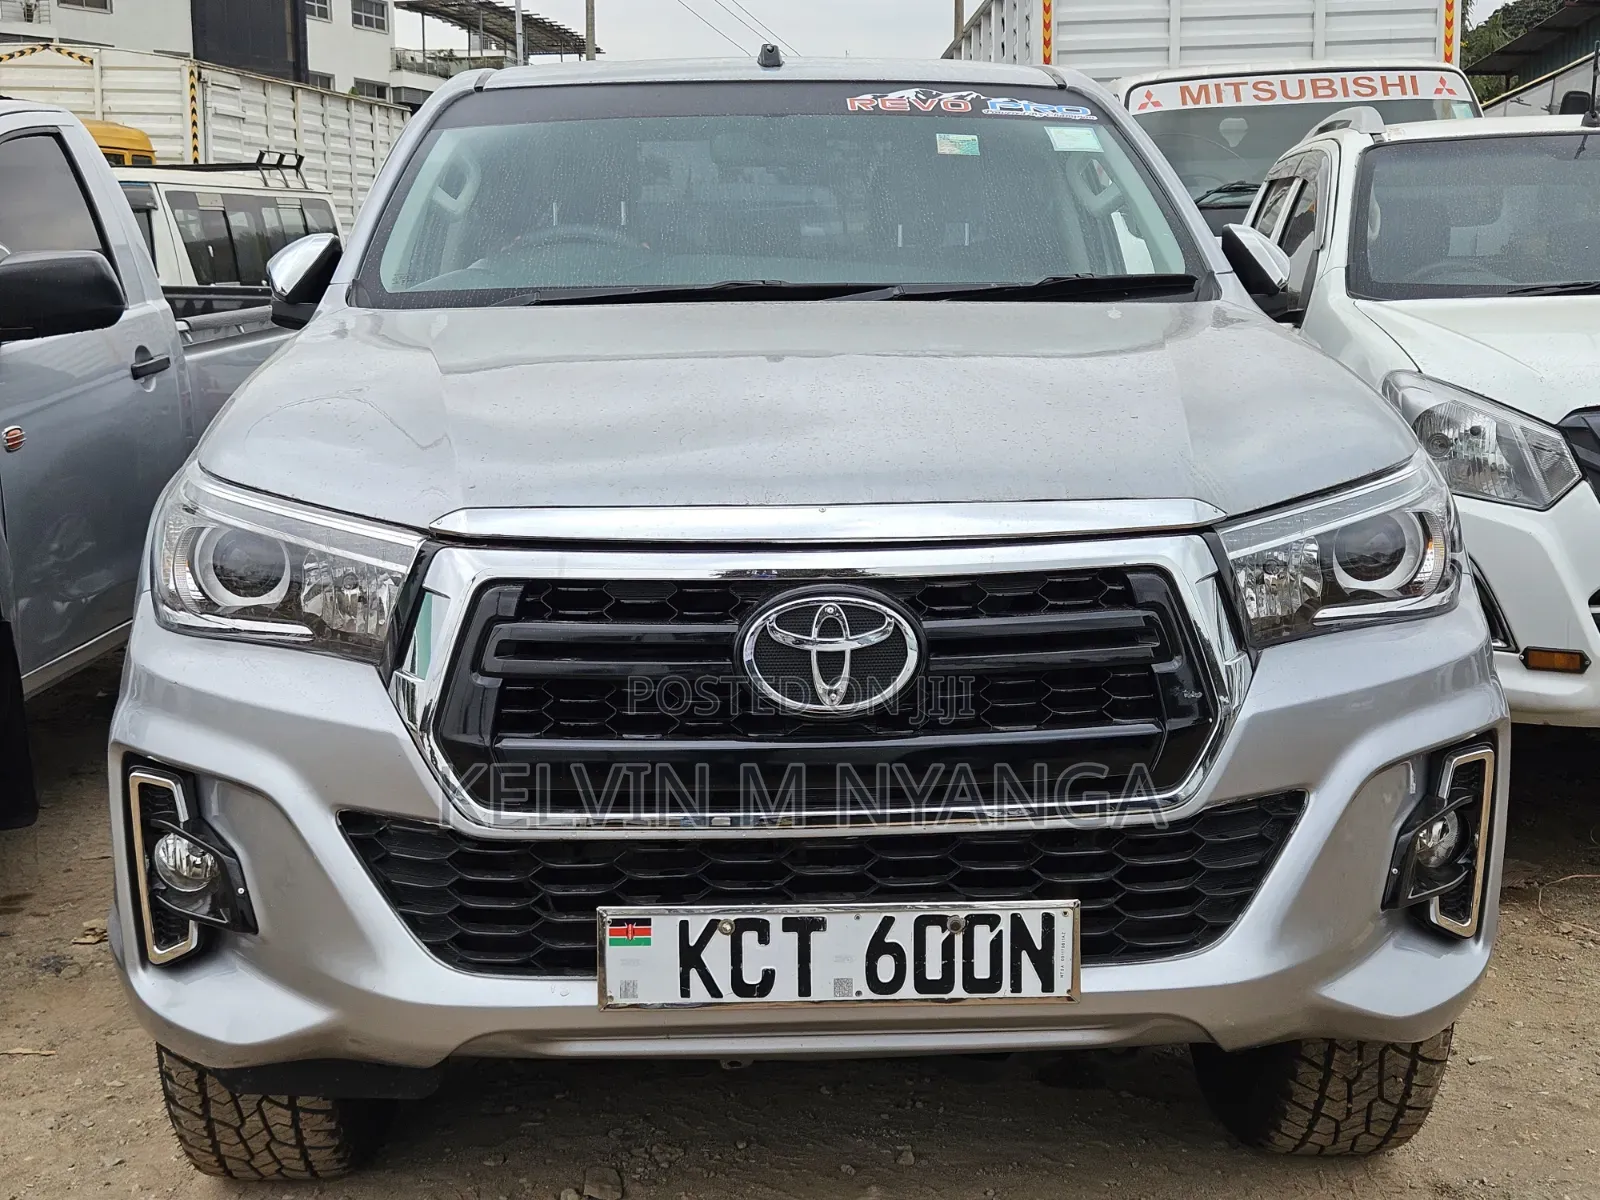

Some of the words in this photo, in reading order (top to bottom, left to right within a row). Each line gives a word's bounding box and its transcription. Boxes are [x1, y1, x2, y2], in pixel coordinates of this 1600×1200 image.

[1179, 75, 1419, 106] MITSUBISHI
[847, 97, 972, 113] REVO
[987, 99, 1092, 116] PRO
[679, 916, 828, 999] KCT
[865, 912, 1055, 996] 600N
